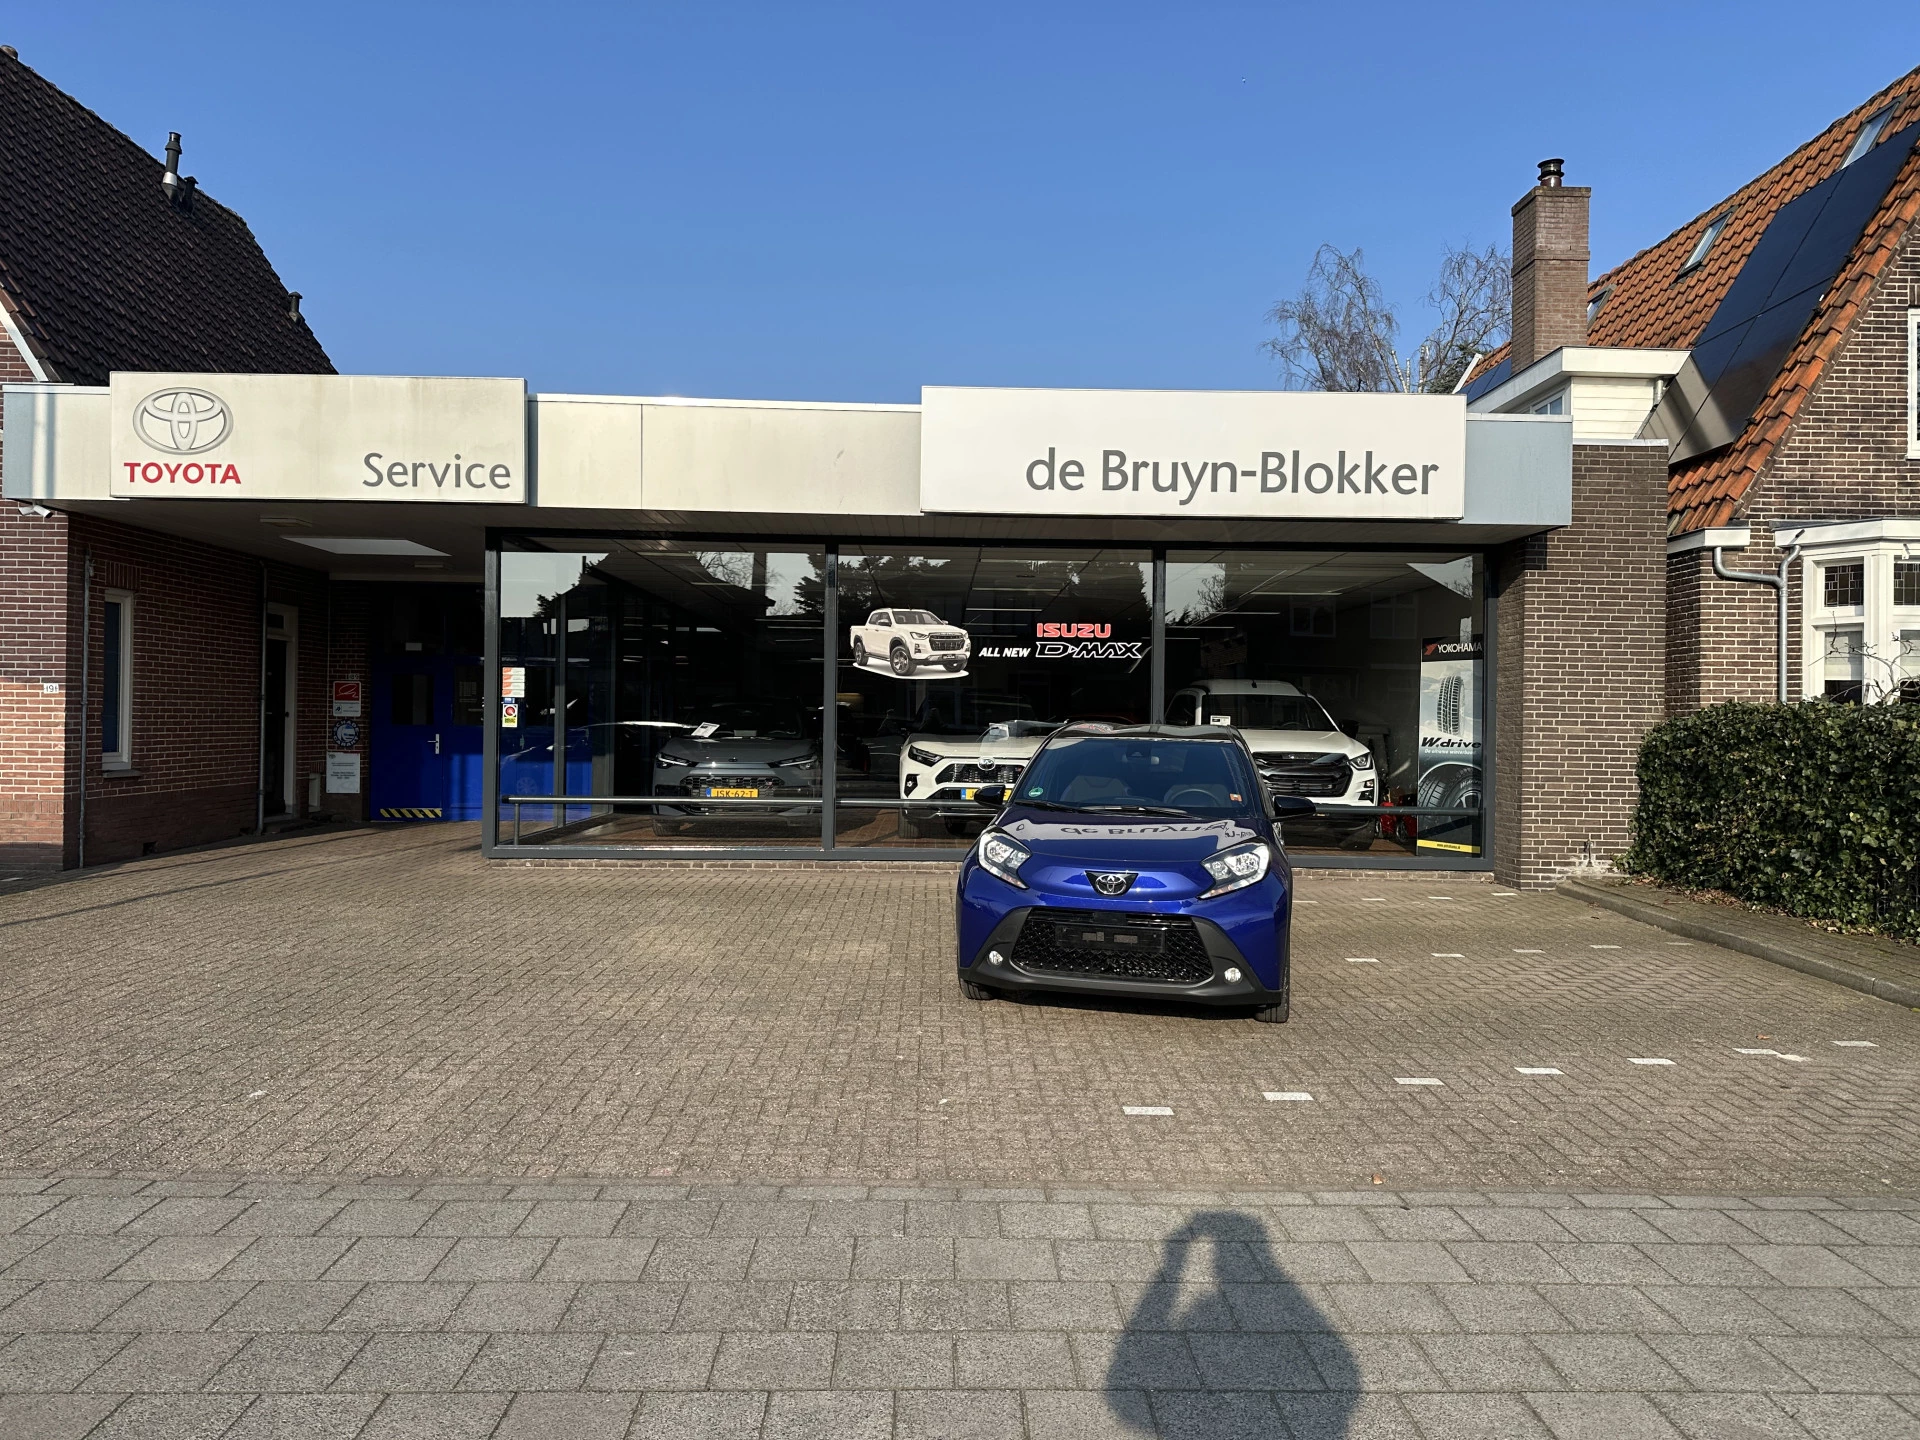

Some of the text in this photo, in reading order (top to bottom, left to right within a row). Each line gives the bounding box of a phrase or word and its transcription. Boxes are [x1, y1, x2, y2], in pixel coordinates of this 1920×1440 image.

[123, 461, 242, 485] TOYOTA
[362, 452, 511, 489] Service
[1026, 446, 1440, 506] de Bruyn-Blokker
[1036, 623, 1112, 638] ISUZU
[978, 647, 1000, 658] ALL
[1002, 647, 1032, 658] NEW
[1437, 642, 1483, 653] YOKOHAMA
